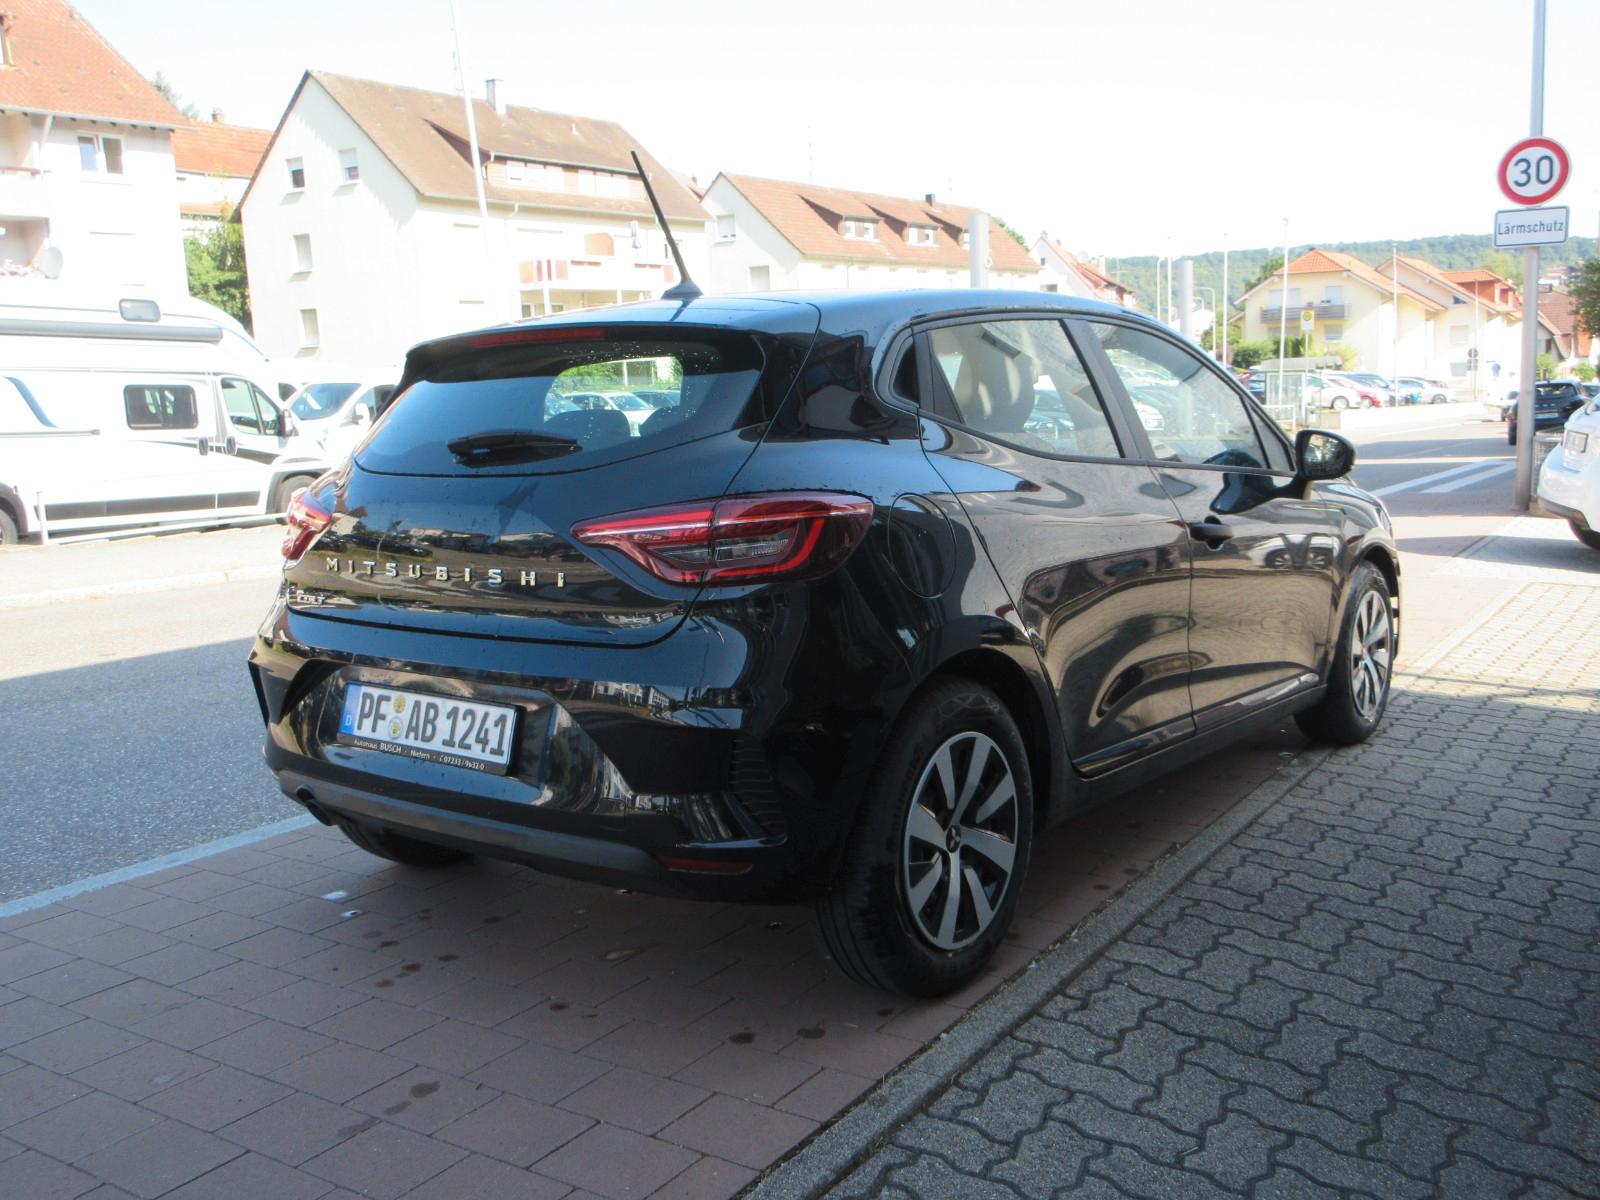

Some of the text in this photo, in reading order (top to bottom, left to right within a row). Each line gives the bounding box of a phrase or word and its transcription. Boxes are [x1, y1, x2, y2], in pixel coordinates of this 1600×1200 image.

[1513, 155, 1553, 187] 30
[1498, 220, 1564, 235] Lärmschutz
[325, 556, 566, 588] MITSUBISHI
[357, 692, 507, 756] PF AB 1241
[380, 742, 402, 754] BUSCH
